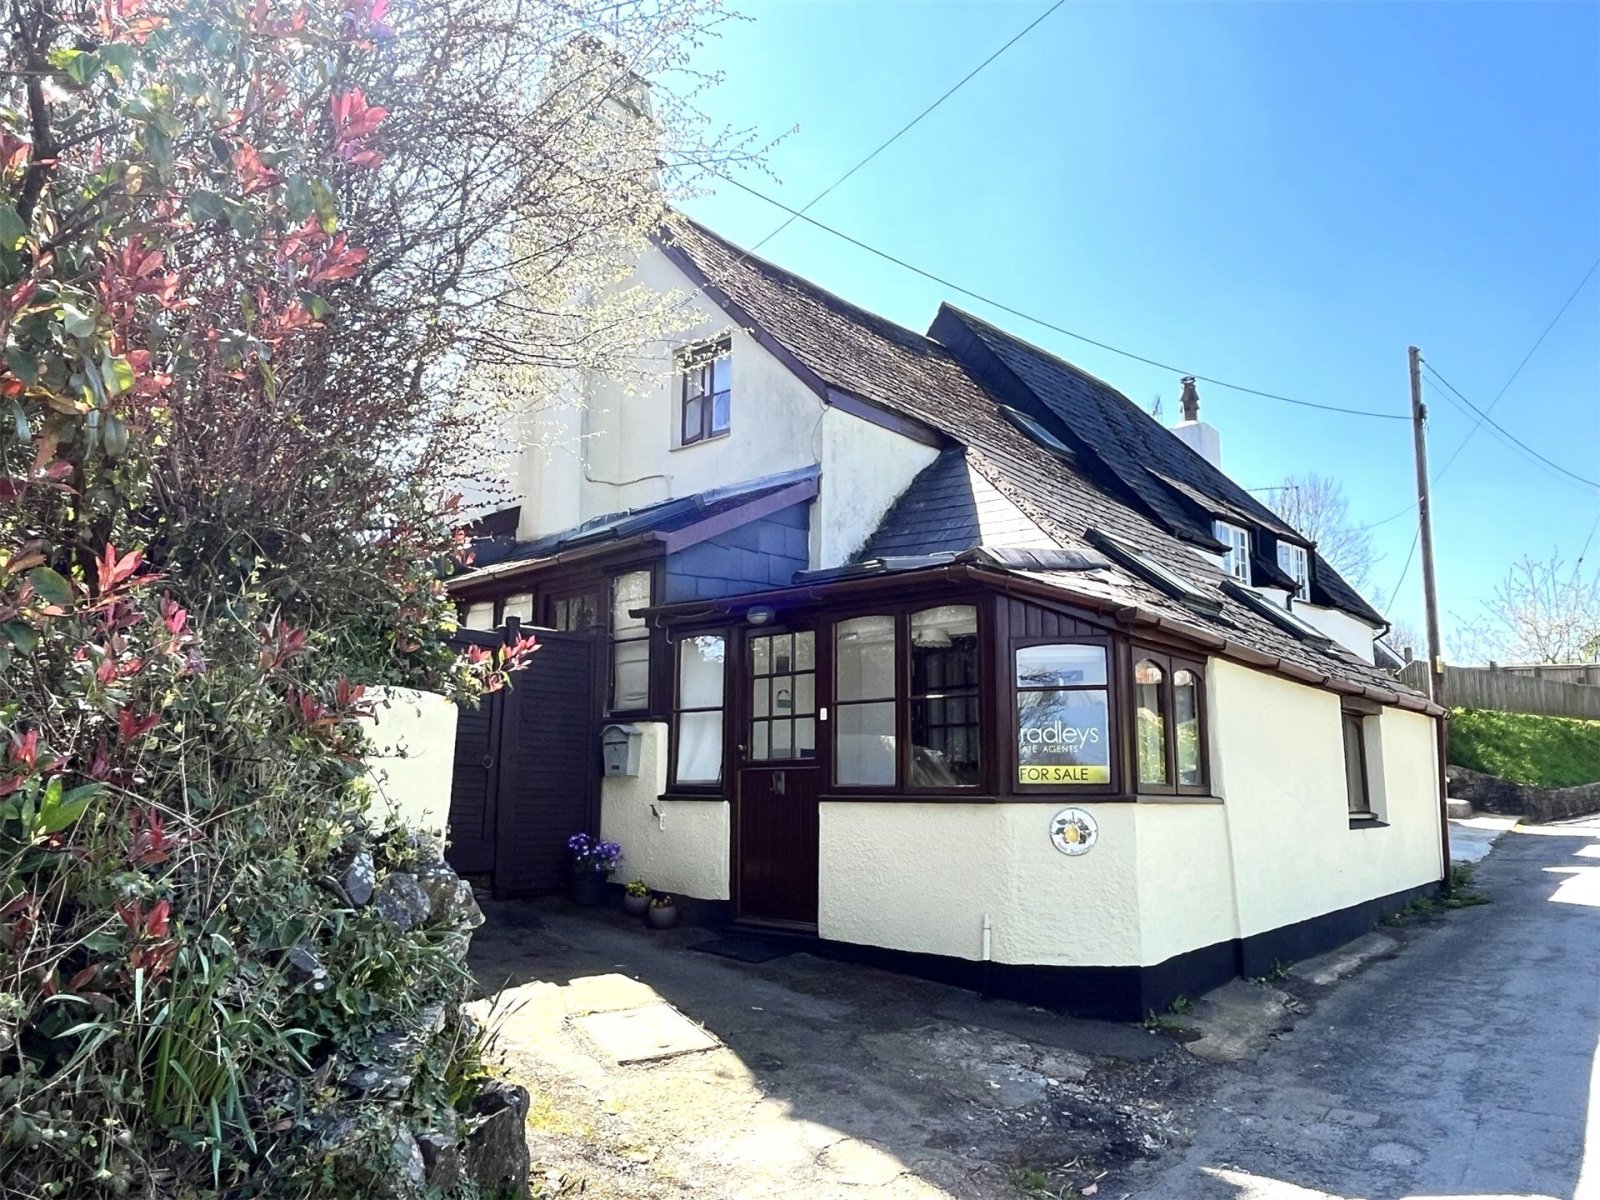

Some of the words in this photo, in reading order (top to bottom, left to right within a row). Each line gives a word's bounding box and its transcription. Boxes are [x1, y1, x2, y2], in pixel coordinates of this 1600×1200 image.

[1042, 744, 1079, 753] AGENTS
[1020, 768, 1049, 781] FOR
[1054, 768, 1088, 781] SALE
